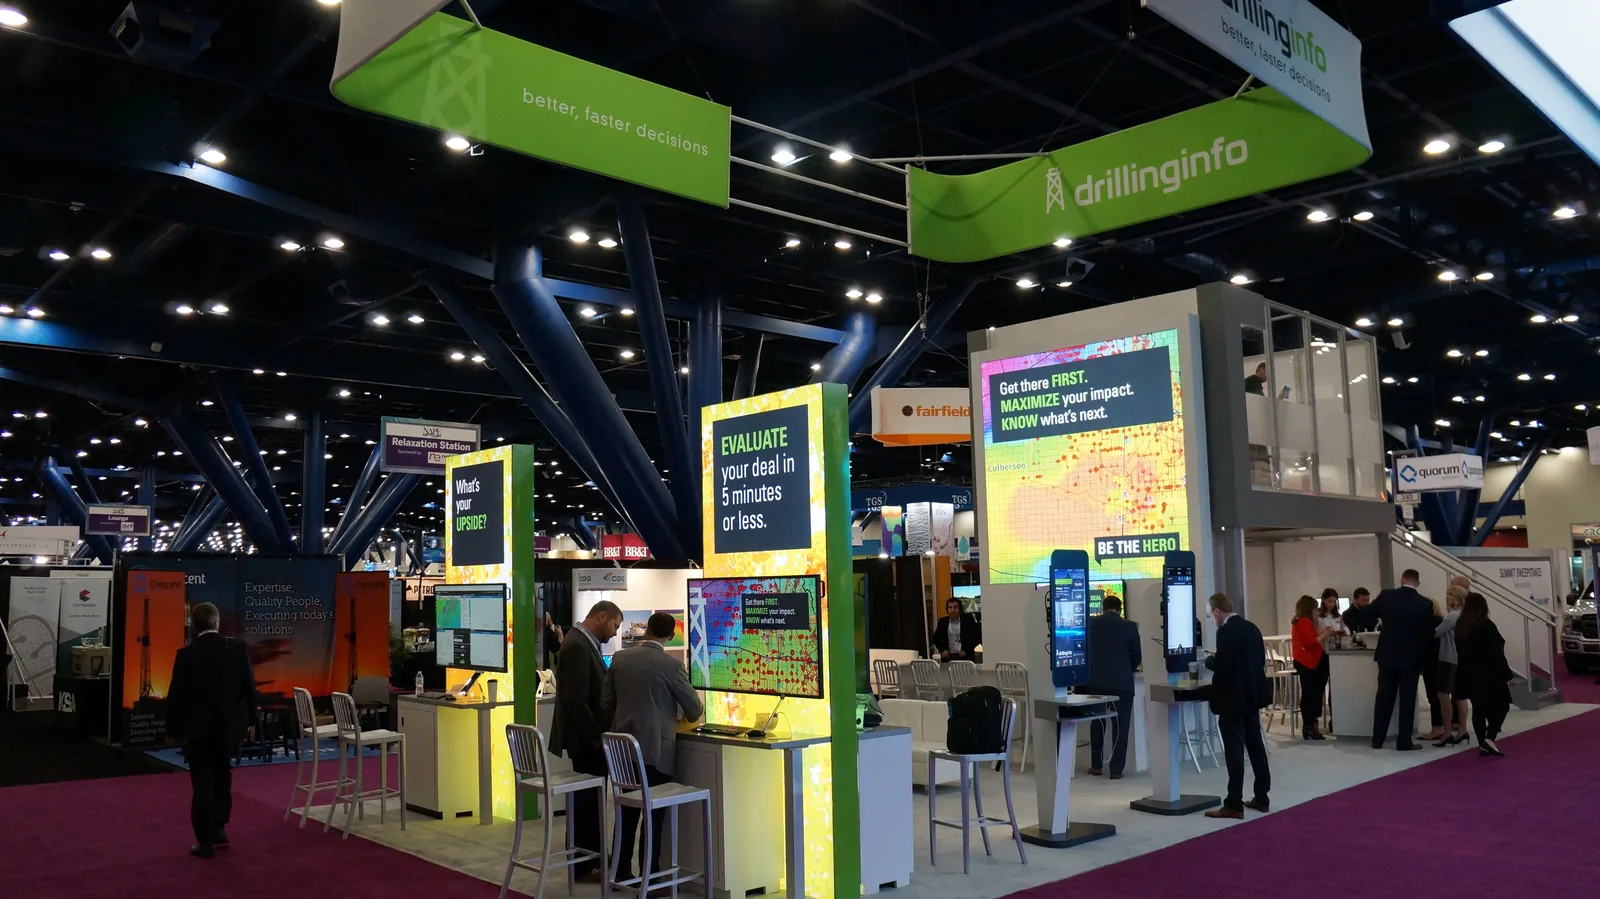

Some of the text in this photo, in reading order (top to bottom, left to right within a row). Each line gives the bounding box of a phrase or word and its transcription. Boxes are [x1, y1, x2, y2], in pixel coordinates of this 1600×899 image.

[1221, 16, 1331, 103] better, faster decisions
[523, 87, 709, 156] better, faster decisions
[1074, 136, 1248, 207] drillinginfo
[1000, 370, 1088, 396] Get there FIRST.
[1001, 383, 1134, 413] MAXIMIZE your impact.
[916, 405, 971, 417] fairfield
[1001, 406, 1108, 431] KNOW what's next.
[392, 437, 471, 451] Relaxation Station
[721, 426, 788, 456] EVALUATE
[721, 453, 795, 486] your deal in
[987, 462, 1026, 473] Culberson
[1419, 464, 1460, 478] quorum
[456, 477, 480, 494] What's
[722, 484, 782, 506] 5 minutes
[866, 497, 882, 506] TGS
[952, 495, 968, 504] TGS
[456, 498, 472, 514] your
[456, 514, 487, 531] UPSIDE?
[722, 510, 767, 531] or less.
[604, 546, 621, 557] BB&T
[625, 546, 648, 557] BB&T
[1097, 538, 1176, 555] BE THE HERO
[184, 573, 206, 584] cent
[1499, 567, 1542, 578] SUMMIT SWEEPSTAKES
[151, 580, 181, 589] Crescent
[245, 582, 295, 594] Expertise,
[413, 585, 434, 594] PTRO
[244, 596, 322, 608] Quality People,
[753, 598, 764, 606] there
[245, 610, 297, 622] Executing
[745, 607, 795, 616] MAXIMIZE your impact.
[746, 616, 760, 624] KNOW
[245, 625, 293, 635] solutions
[58, 691, 76, 712] KSA
